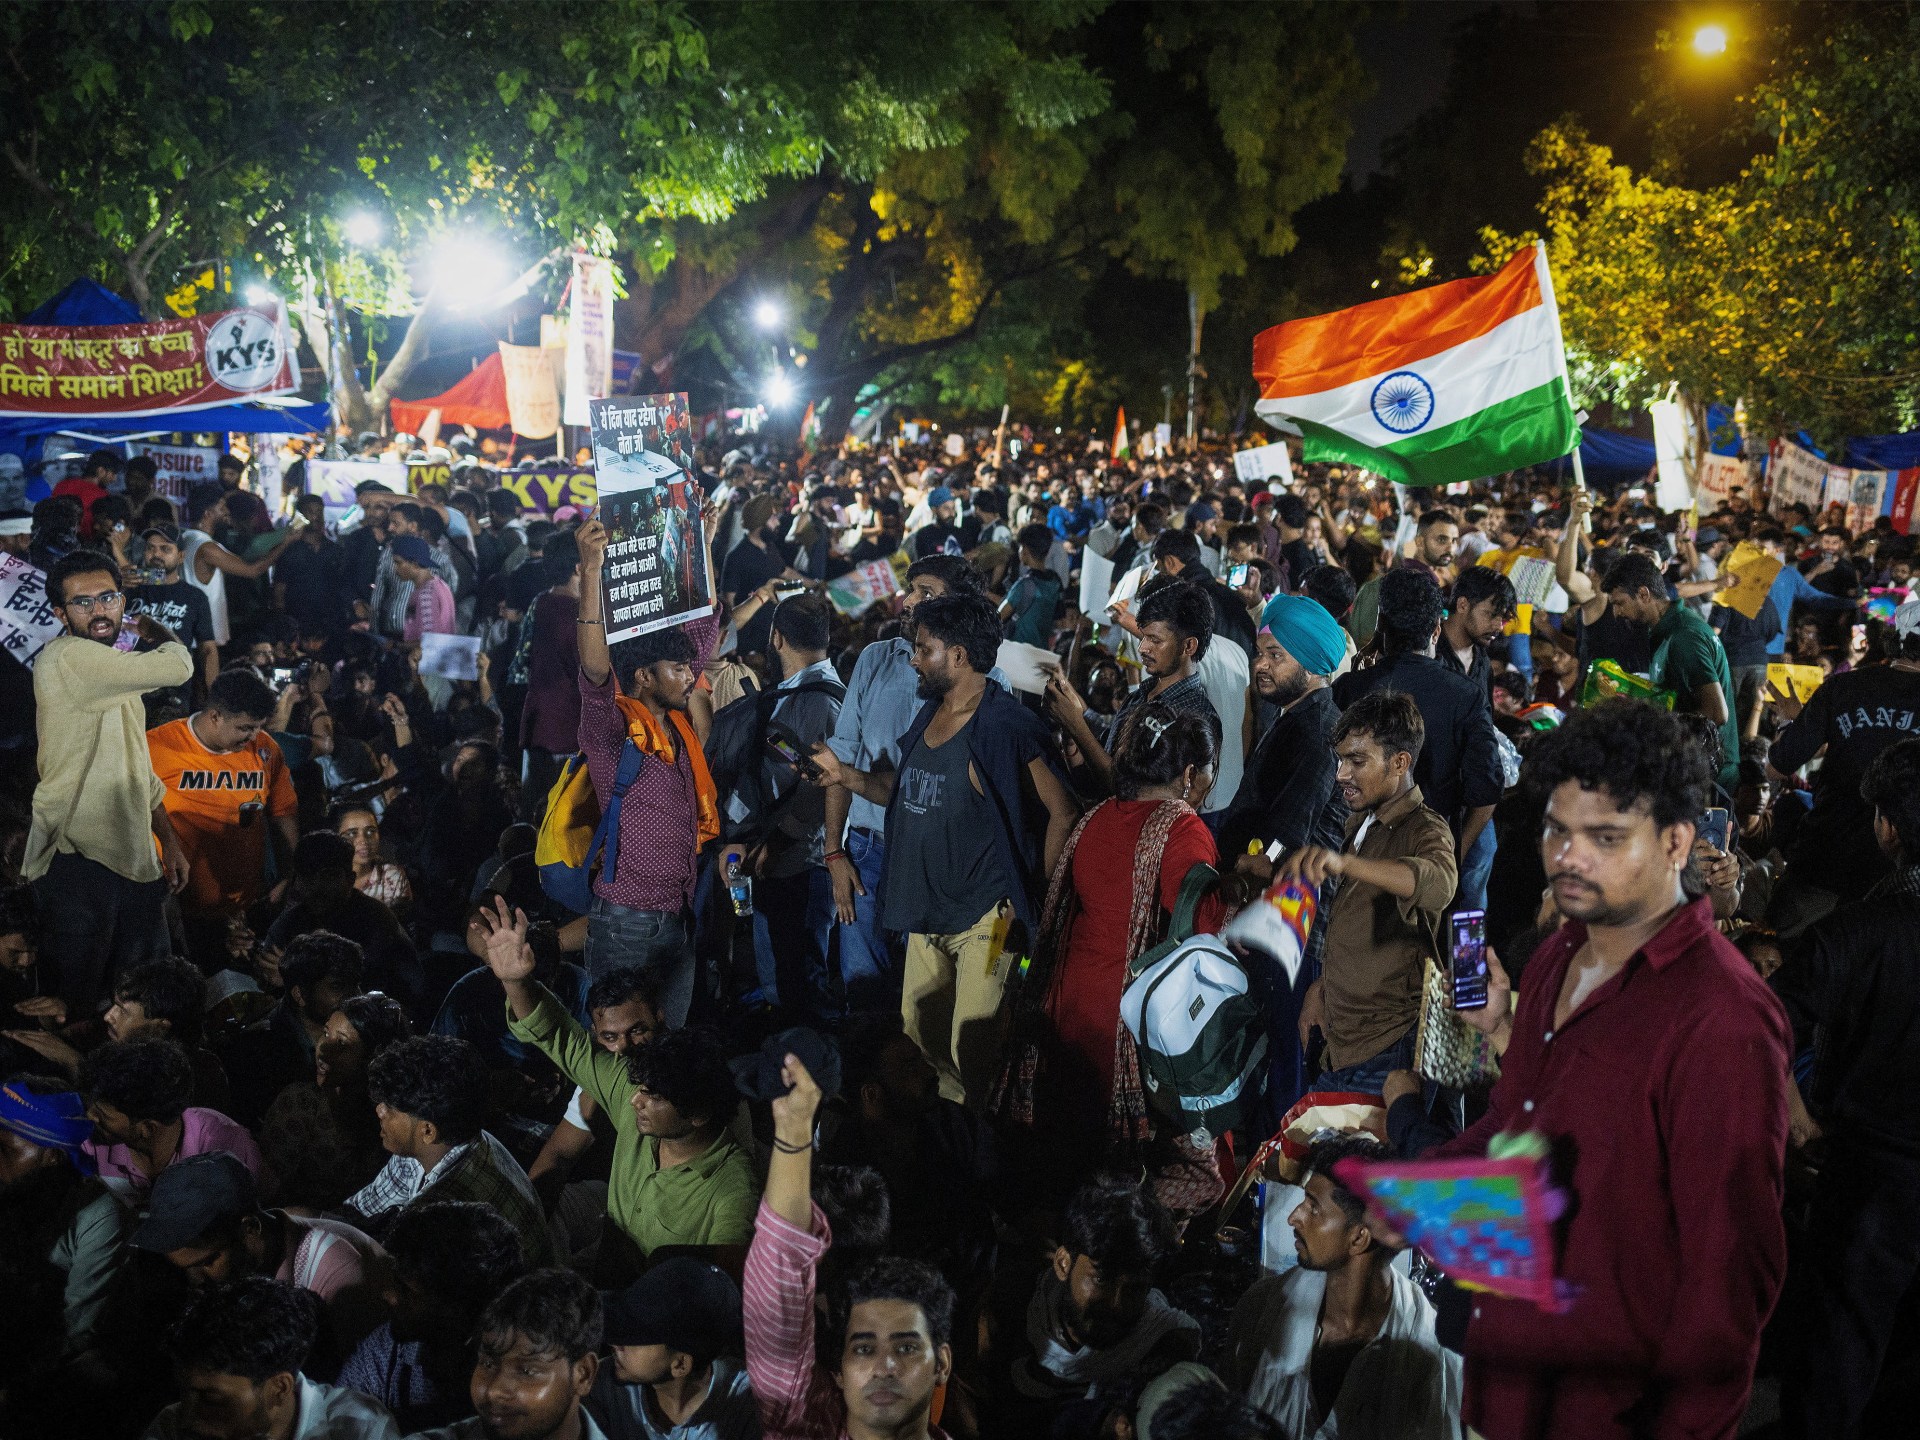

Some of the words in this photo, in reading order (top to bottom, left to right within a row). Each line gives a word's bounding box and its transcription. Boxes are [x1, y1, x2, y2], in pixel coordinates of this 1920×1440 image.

[2, 329, 27, 361] हो
[27, 338, 57, 360] या
[57, 338, 114, 369] मजदूर
[217, 339, 275, 371] KYS
[0, 363, 53, 398] मिले
[56, 375, 126, 399] समान
[128, 362, 203, 397] शिक्षा!
[501, 473, 598, 508] KYS
[1836, 706, 1920, 739] PANJ
[178, 769, 265, 791] MIAMI
